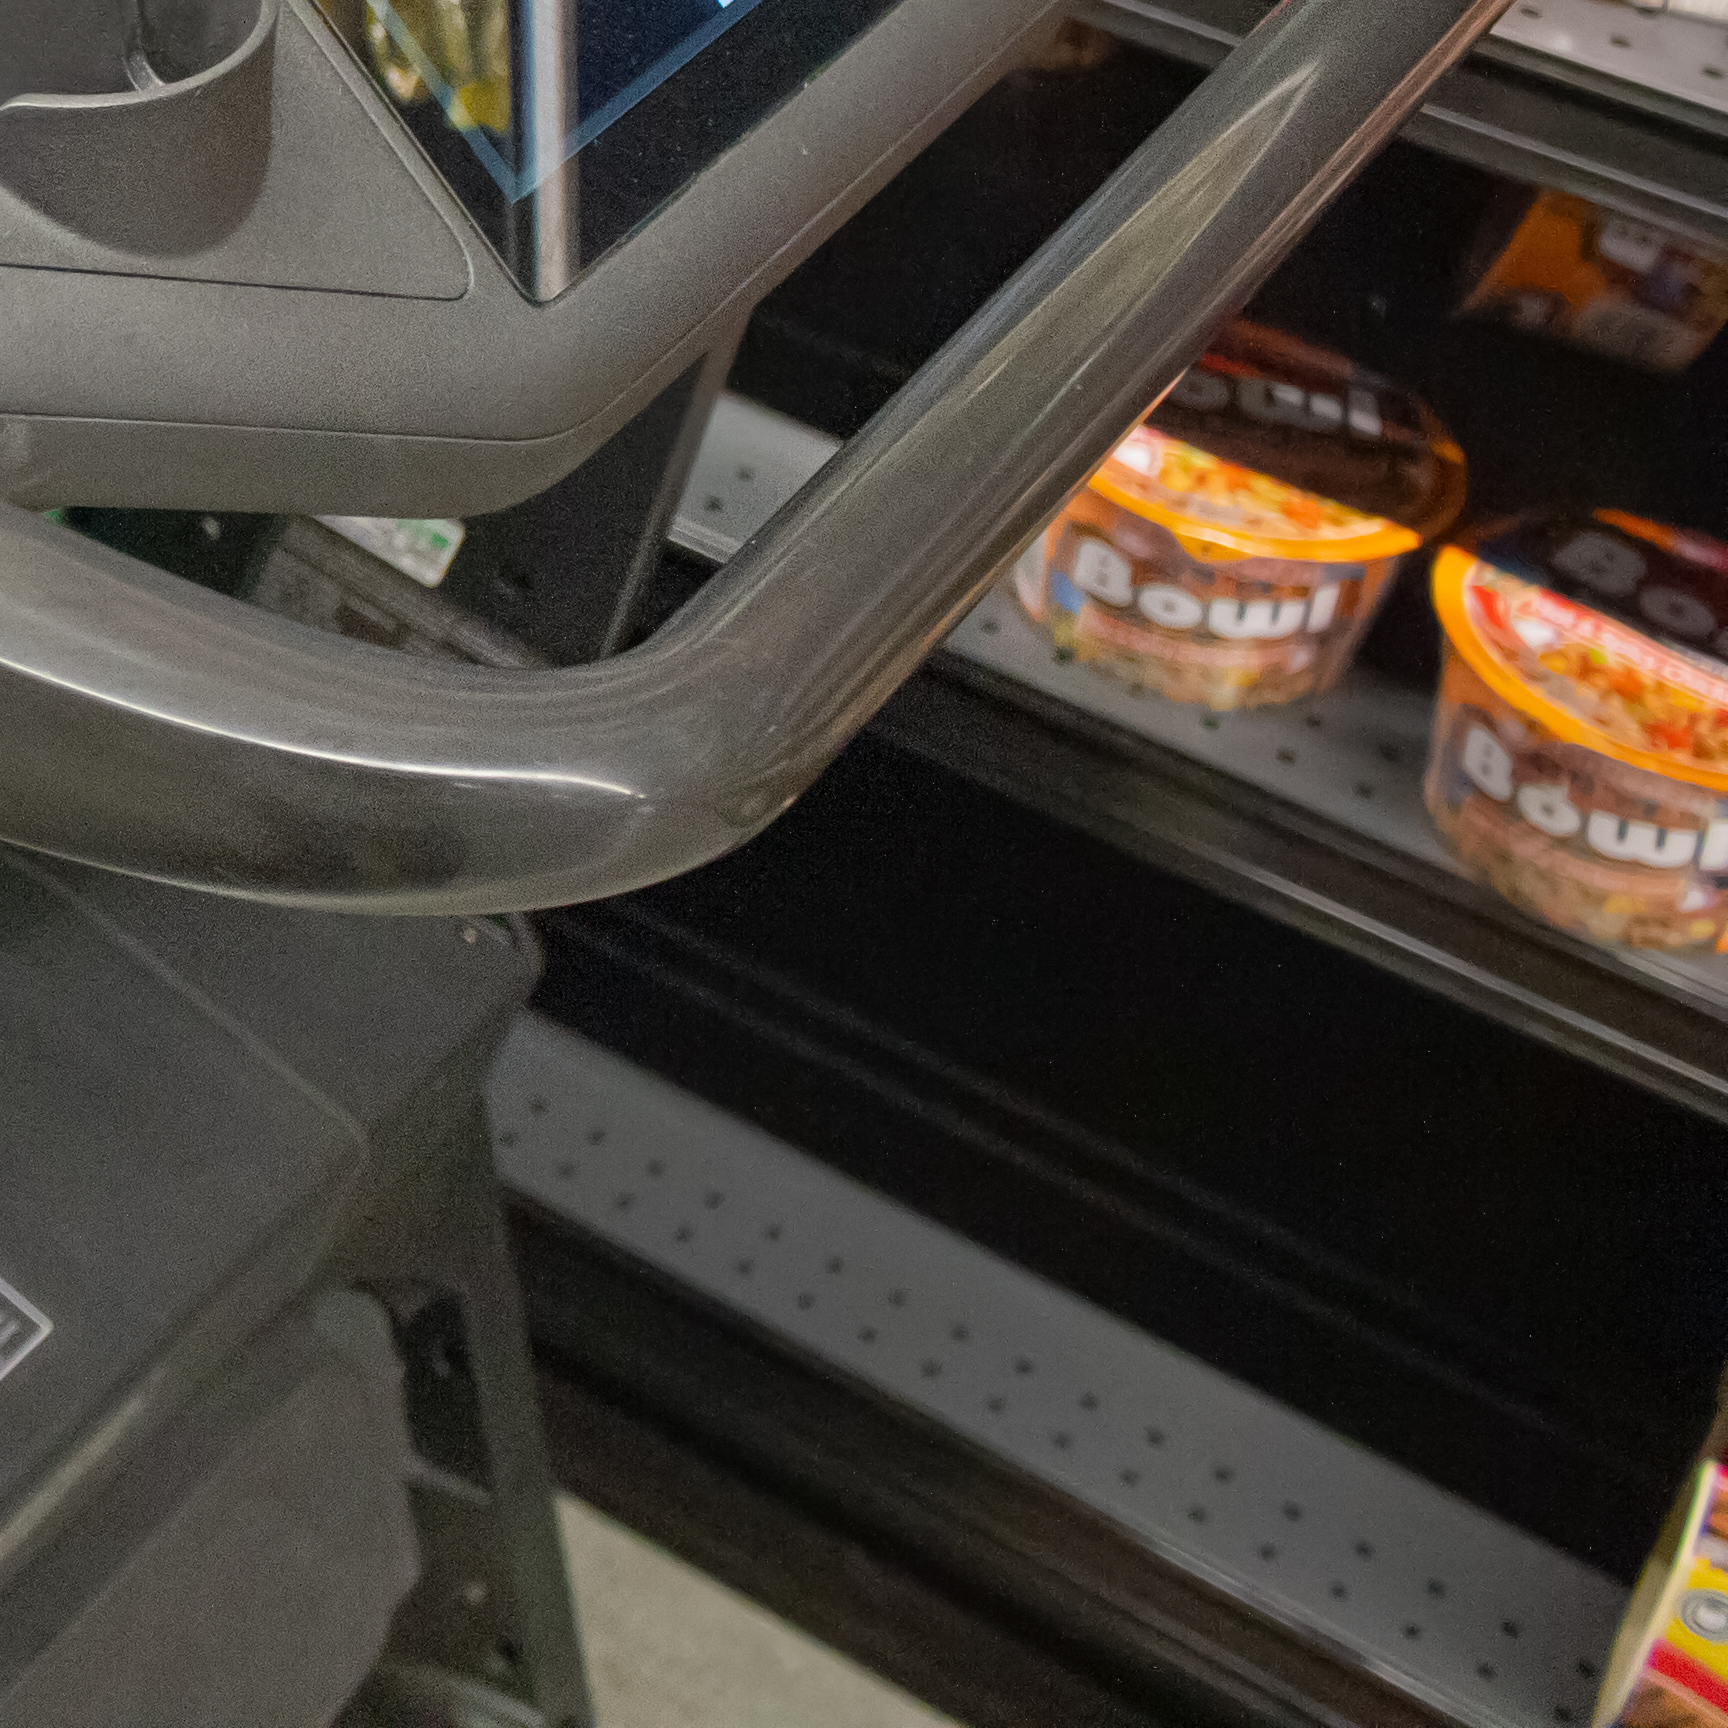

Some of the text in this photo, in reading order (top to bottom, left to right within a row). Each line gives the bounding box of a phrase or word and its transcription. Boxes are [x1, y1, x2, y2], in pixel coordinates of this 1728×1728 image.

[1163, 370, 1383, 439] owl
[1073, 537, 1341, 639] Bowl
[1463, 719, 1728, 871] Bowl
